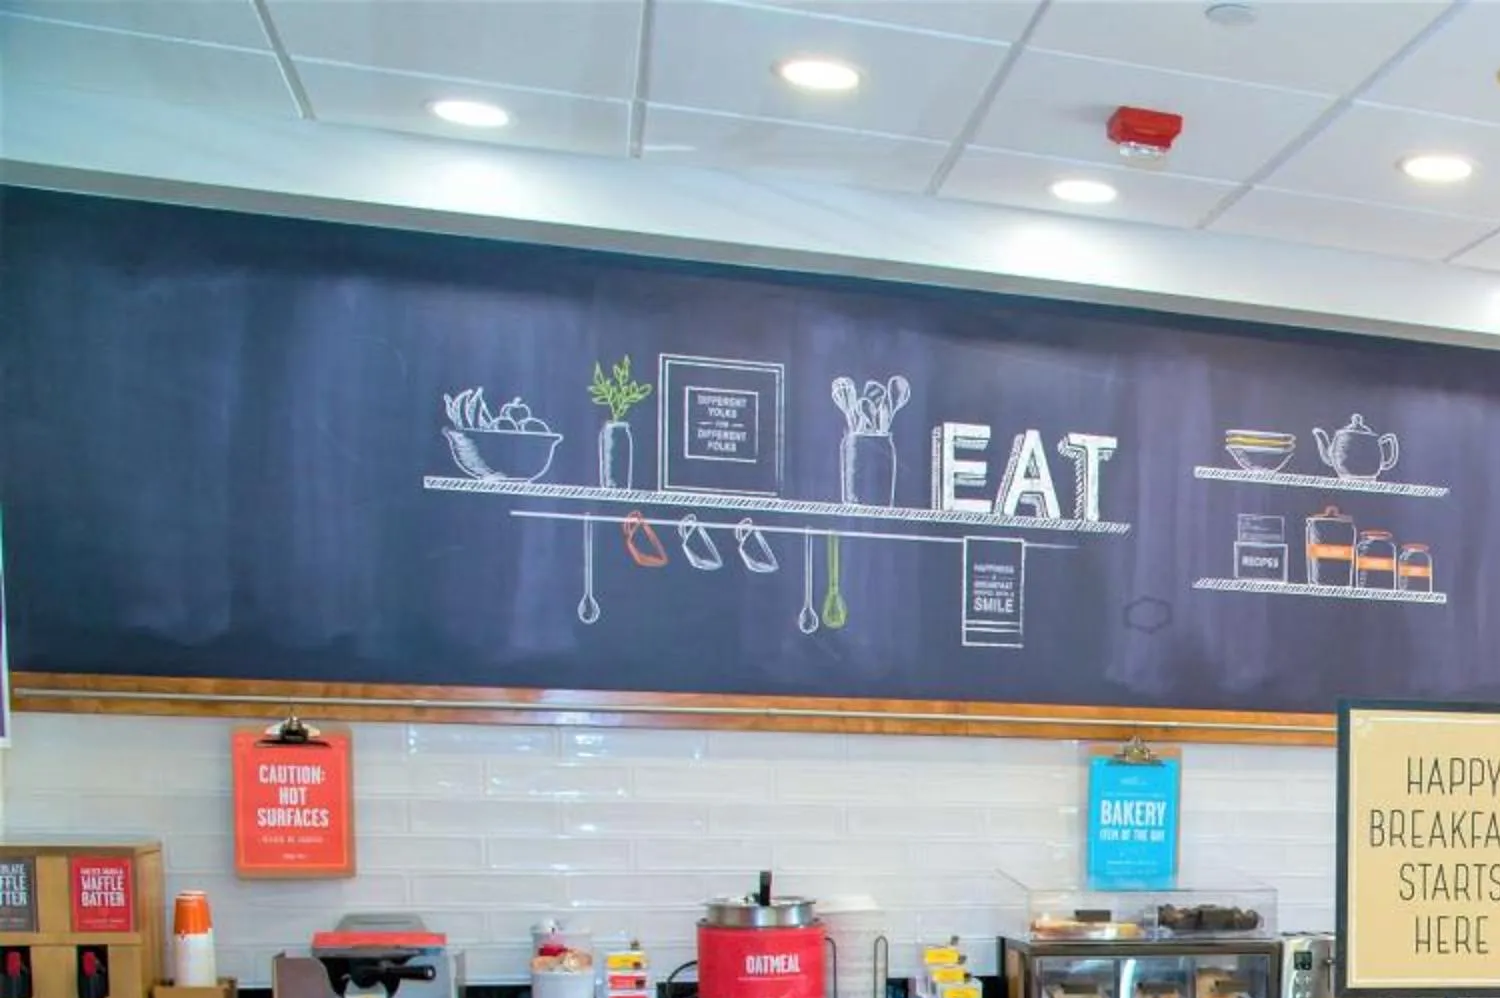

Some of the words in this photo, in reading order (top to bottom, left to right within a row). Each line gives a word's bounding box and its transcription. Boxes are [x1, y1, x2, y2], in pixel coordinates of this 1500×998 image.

[932, 422, 1118, 521] EAT
[974, 597, 1014, 613] SMILE
[258, 764, 327, 785] CAUTION:
[278, 786, 307, 806] HOT
[257, 807, 330, 828] SURFACES
[1100, 799, 1167, 827] BAKERY
[80, 874, 125, 891] WAFFLE
[80, 891, 126, 907] BATTER
[1415, 915, 1489, 954] HERE
[745, 953, 801, 975] OATMEAL
